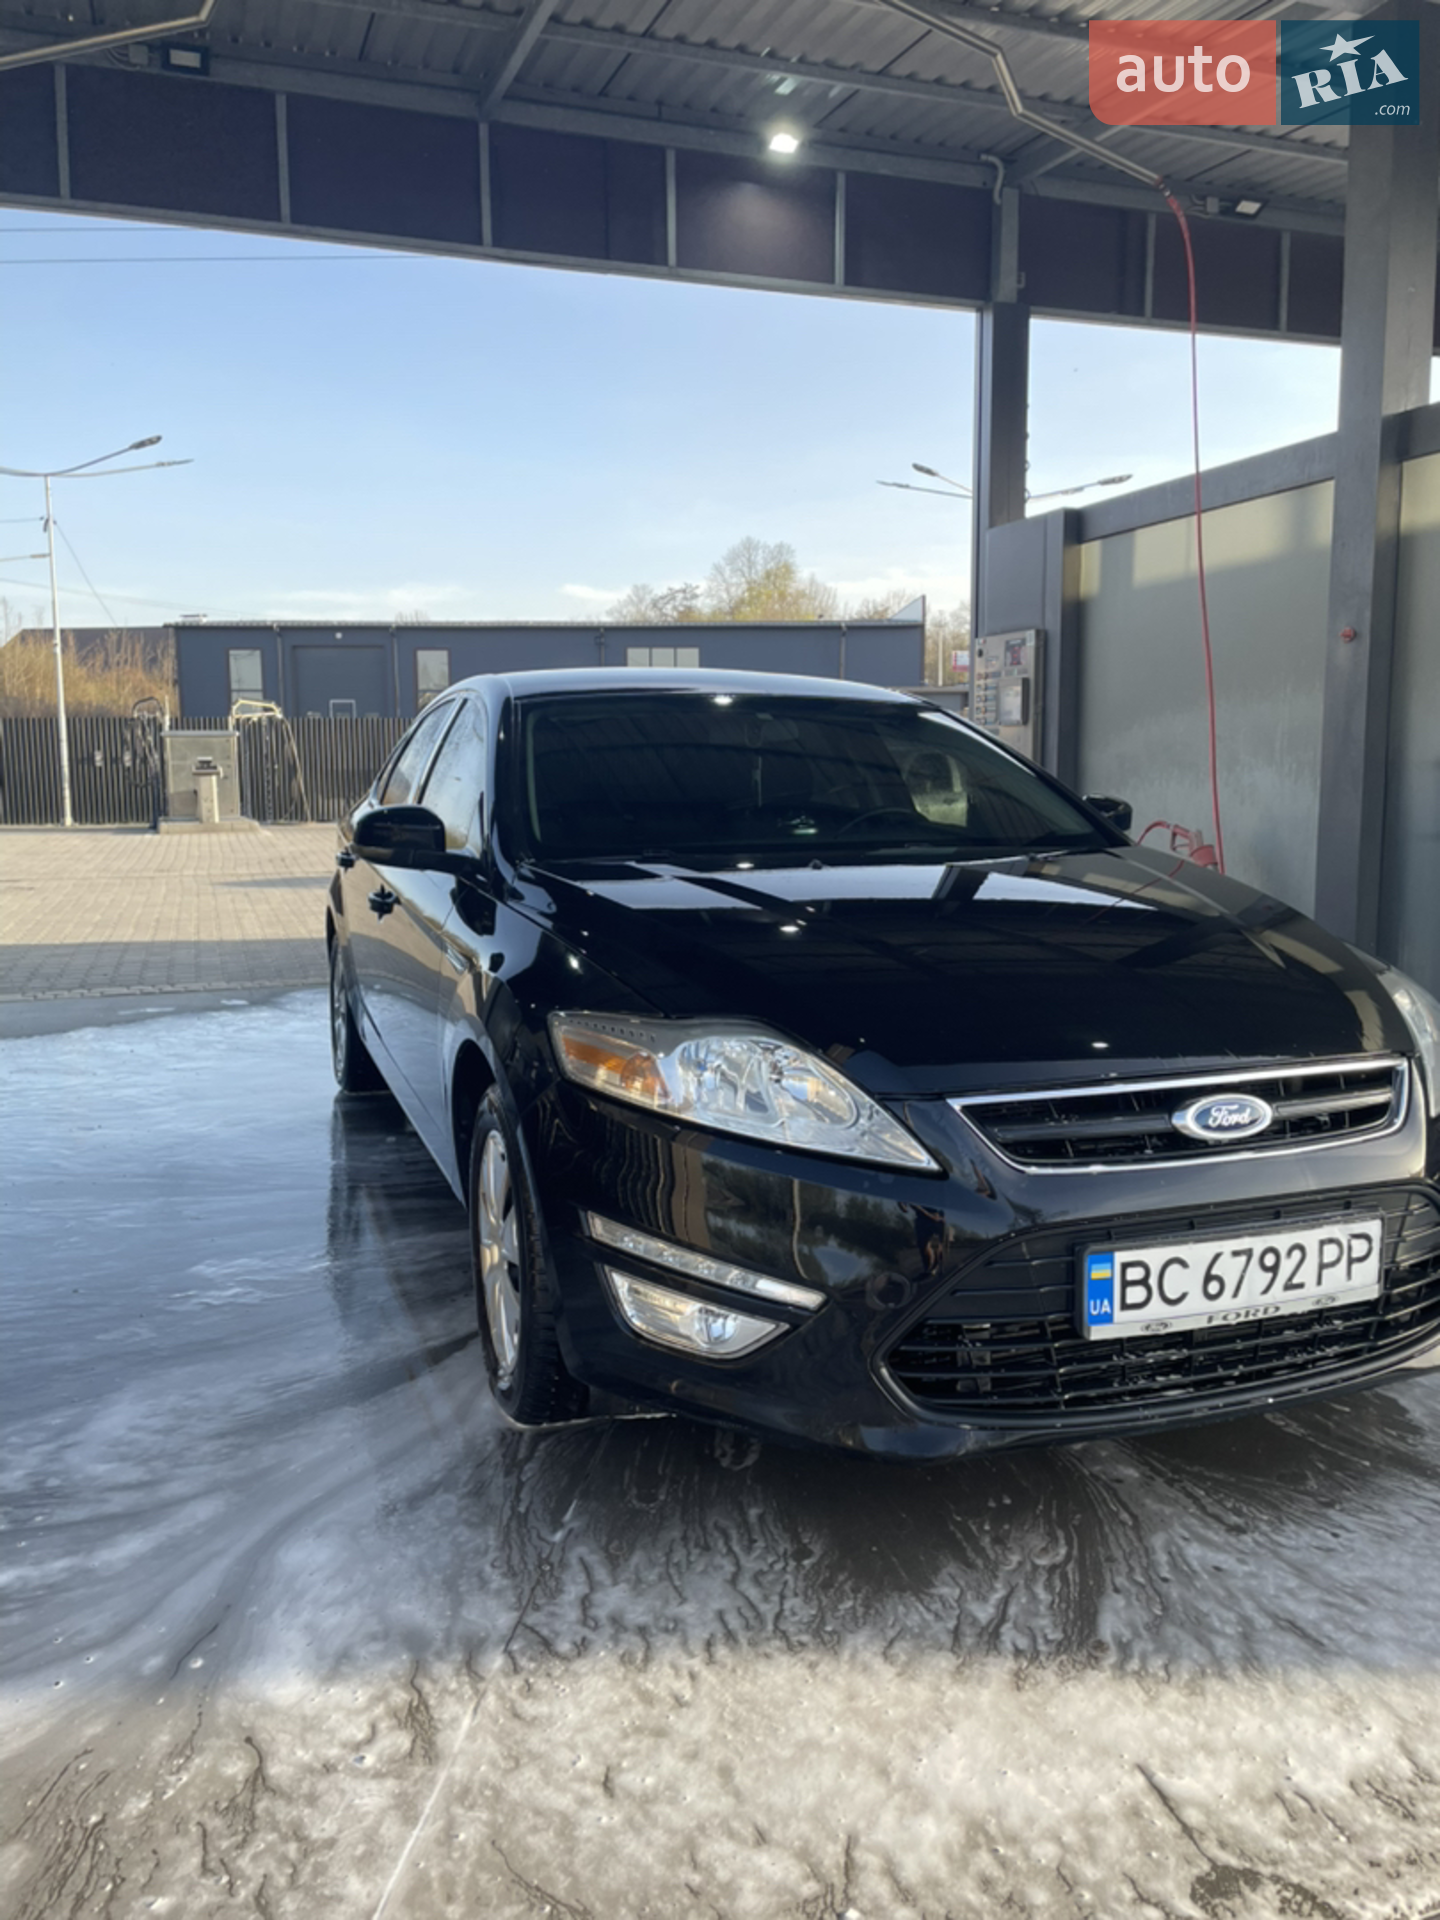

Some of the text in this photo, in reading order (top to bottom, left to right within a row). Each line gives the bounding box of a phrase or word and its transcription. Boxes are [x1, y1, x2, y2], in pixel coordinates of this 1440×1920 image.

[1208, 1104, 1252, 1128] Ford
[1119, 1232, 1373, 1311] BC 6792 PP
[1089, 1299, 1111, 1315] UA
[1207, 1305, 1281, 1325] FORD
